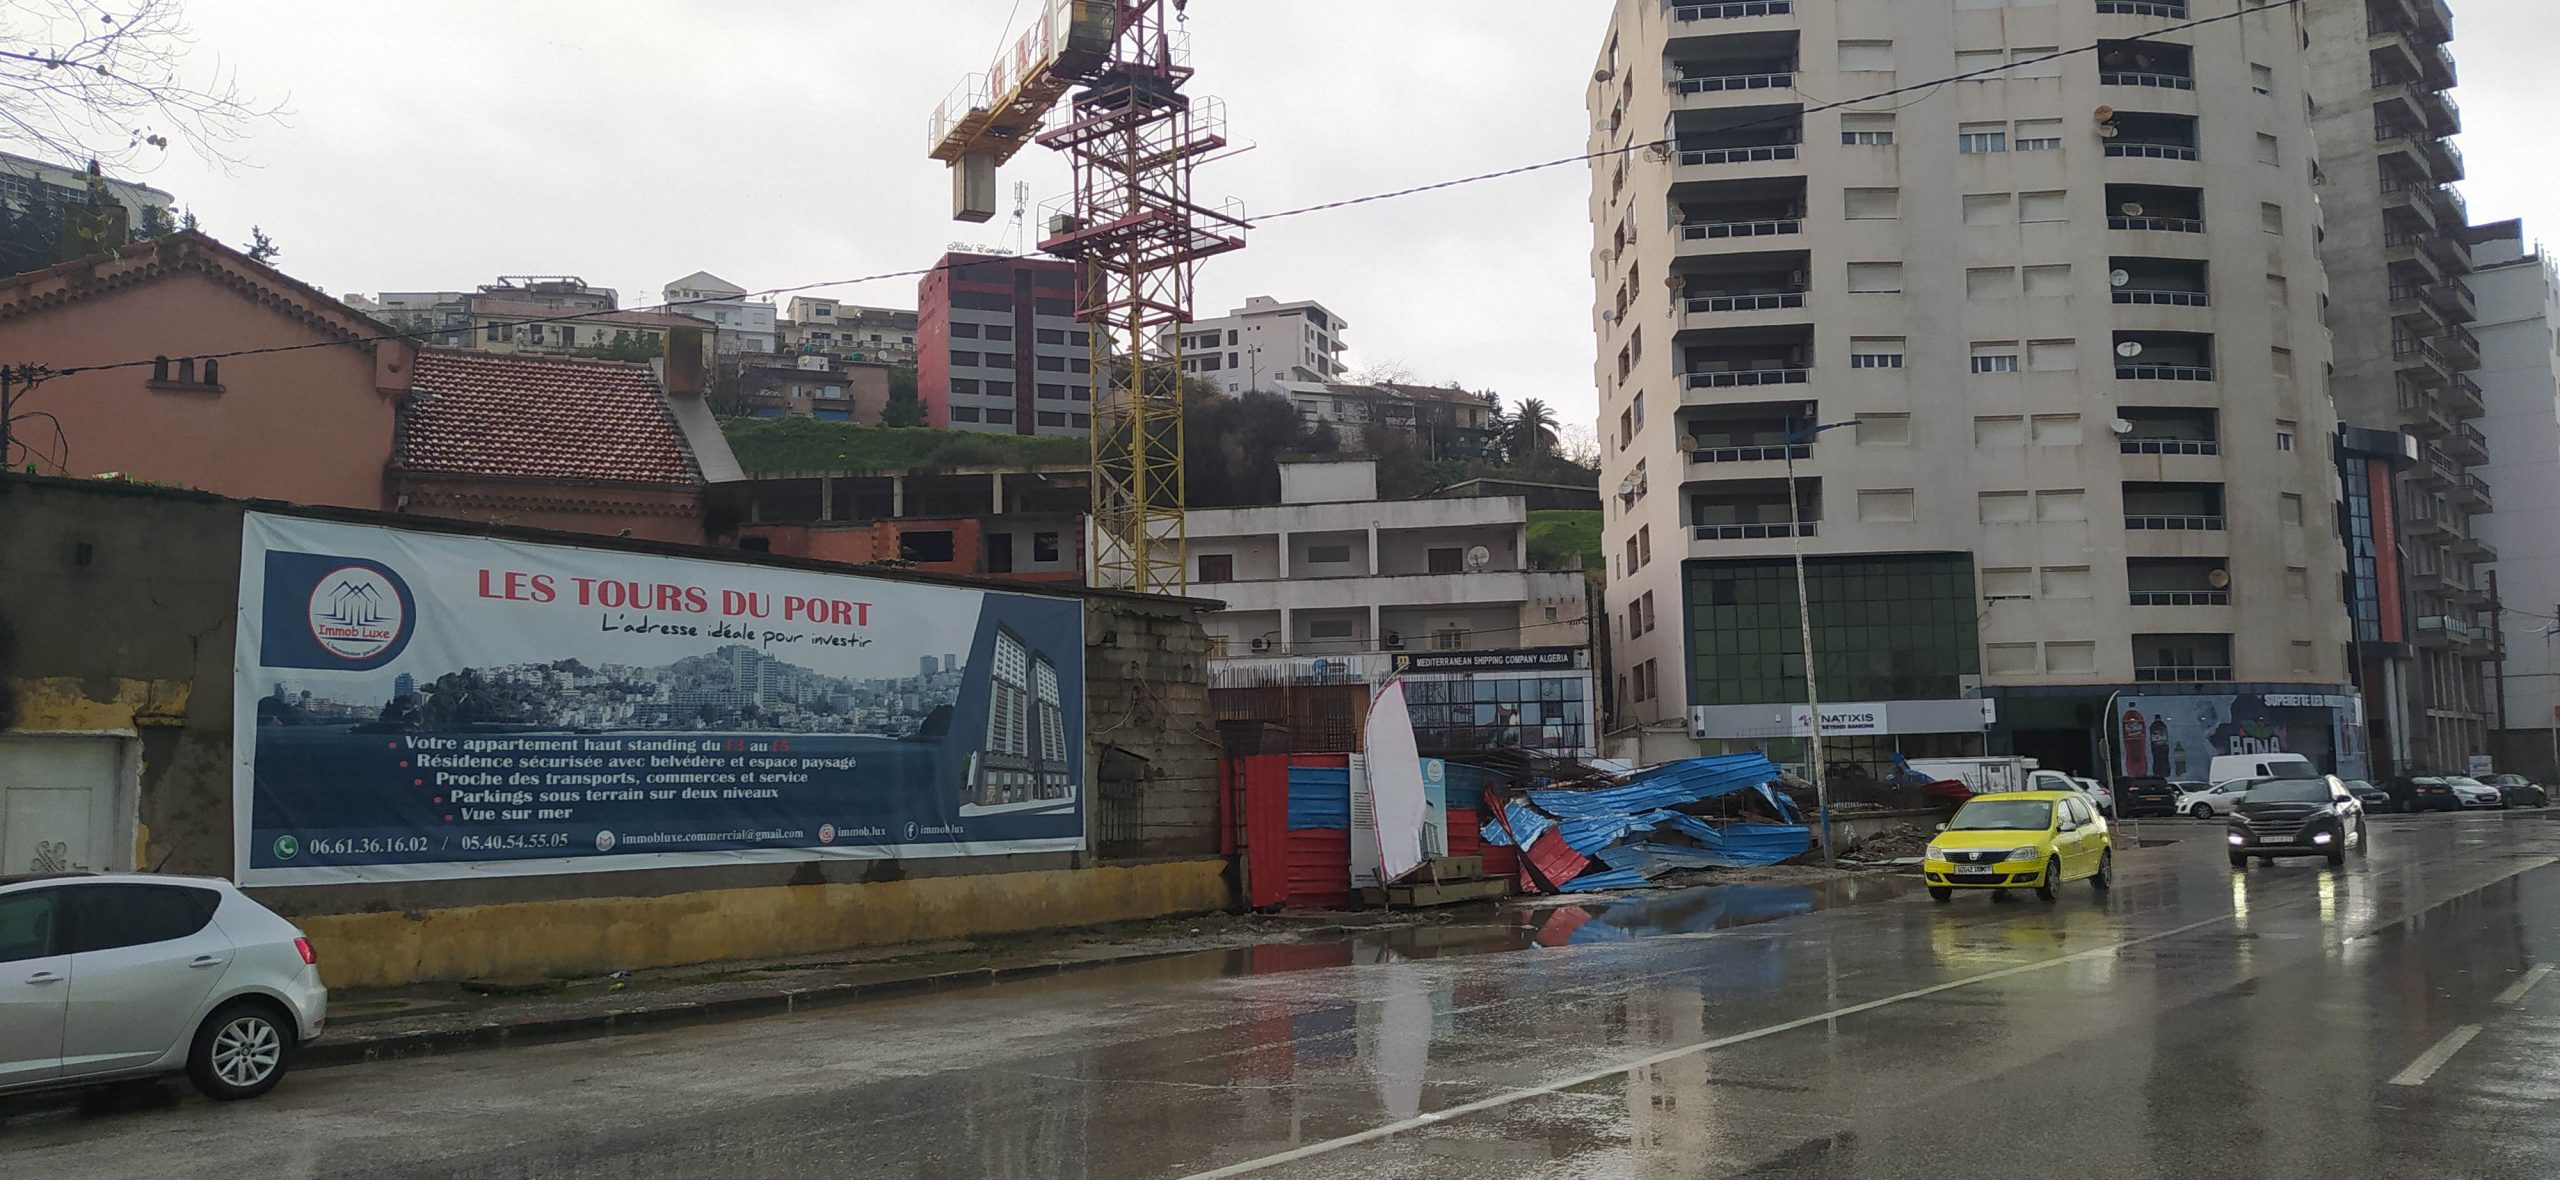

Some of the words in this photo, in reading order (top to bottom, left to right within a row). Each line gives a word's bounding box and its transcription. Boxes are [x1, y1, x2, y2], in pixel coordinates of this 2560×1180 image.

[478, 569, 556, 603] LES
[570, 577, 708, 613] TOURS
[722, 589, 770, 618] DU
[784, 595, 872, 626] PORT
[318, 624, 359, 637] Immob
[362, 627, 391, 638] Luxe
[602, 613, 698, 636] L'adresse
[707, 620, 756, 640] idéale
[762, 630, 803, 649] pour
[811, 632, 872, 648] investir
[1416, 656, 1472, 667] MEDITERRANEAN
[1474, 655, 1503, 665] SHIPPING
[1505, 655, 1537, 664] COMPANY
[1539, 654, 1569, 663] ALGERIA
[1821, 713, 1874, 723] NATIXIS
[405, 736, 457, 750] Votre
[463, 738, 579, 752] appartement
[584, 738, 622, 751] haut
[628, 739, 697, 754] standing
[702, 740, 721, 751] du
[750, 742, 768, 751] au
[417, 753, 514, 768] Résidence
[519, 754, 603, 768] sécurisée
[608, 757, 645, 768] avec
[650, 755, 725, 768] belvédère
[730, 756, 744, 767] et
[749, 758, 798, 770] espace
[802, 756, 857, 770] paysagé
[436, 771, 503, 785] Proche
[509, 772, 540, 785] des
[546, 772, 640, 787] transports,
[646, 773, 736, 784] commerces
[740, 772, 754, 783] et
[759, 771, 808, 783] service
[450, 789, 533, 805] Parkings
[539, 791, 580, 801] sous
[586, 787, 644, 801] terrain
[649, 789, 677, 800] sur
[682, 787, 718, 799] deux
[723, 787, 779, 799] niveaux
[461, 807, 496, 820] Vue
[501, 808, 532, 820] sur
[538, 807, 573, 819] mer
[622, 828, 804, 844] immobluxe.commercial@gmail.com
[838, 826, 886, 838] immob.lux
[310, 836, 428, 855] 06.61.36.16.02
[462, 833, 569, 850] 05.40.54.55.05
